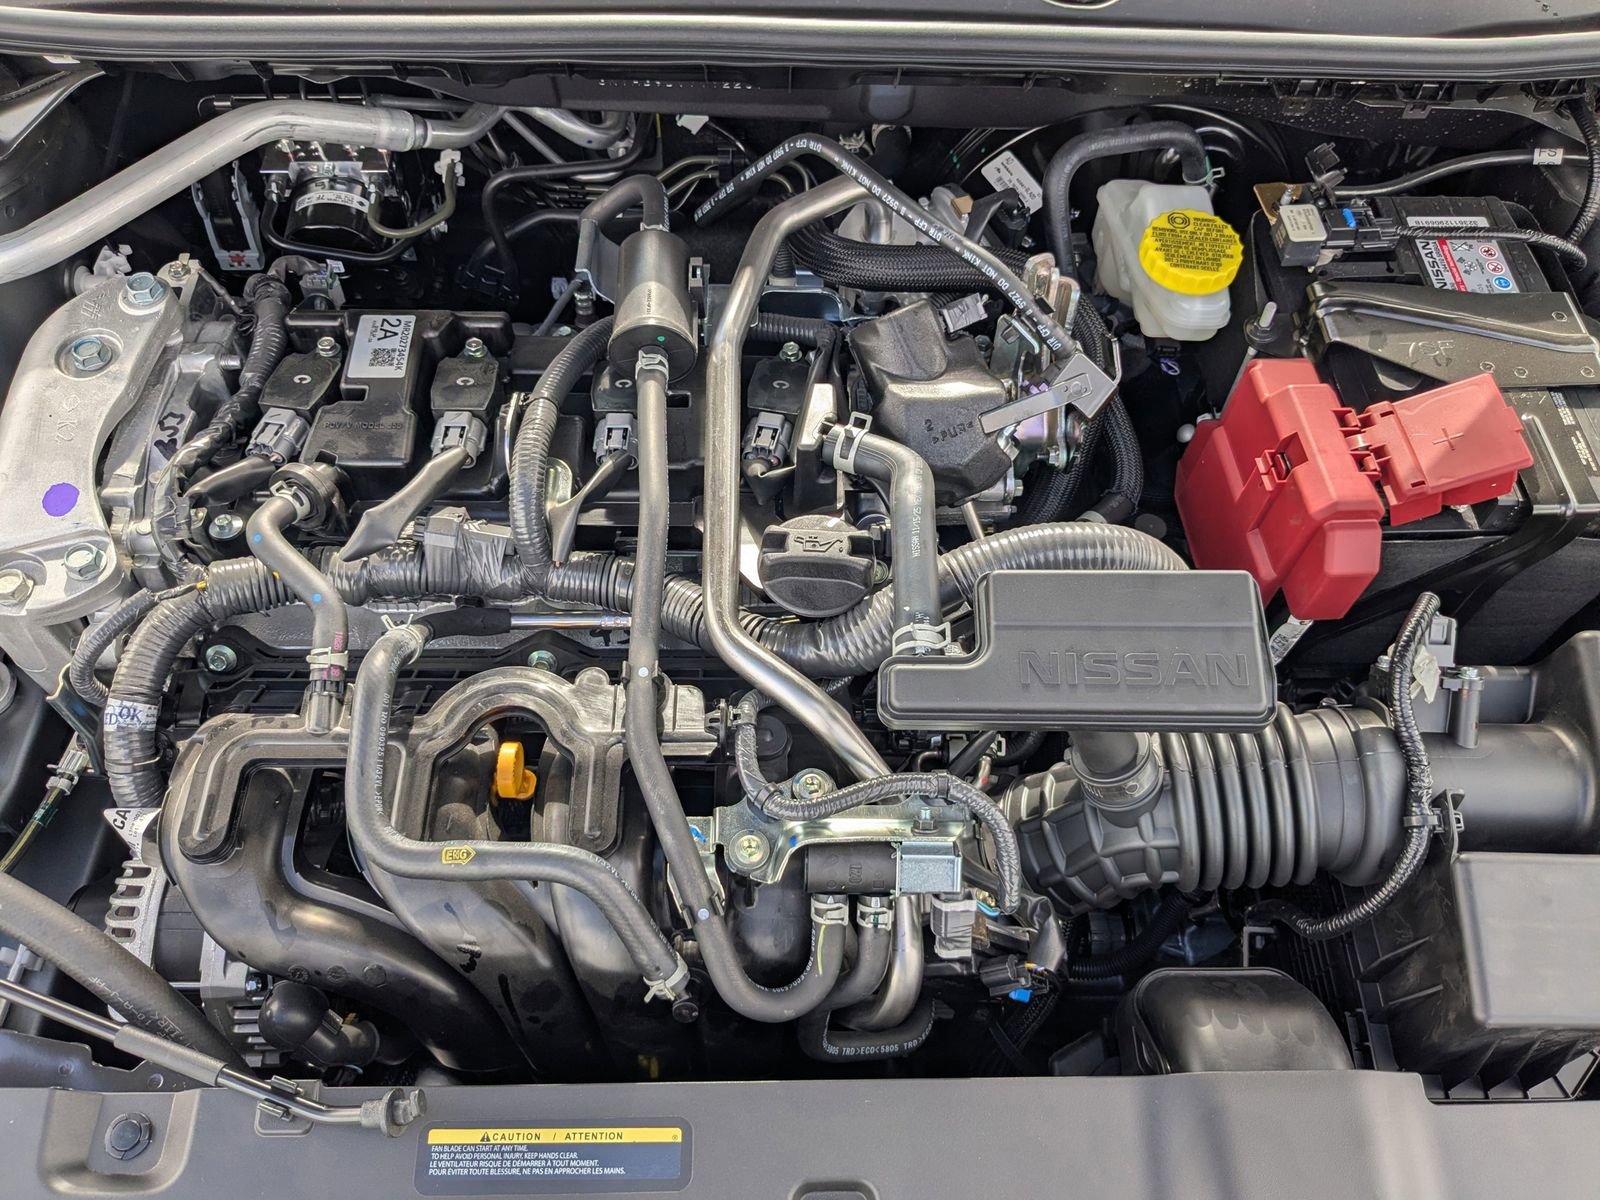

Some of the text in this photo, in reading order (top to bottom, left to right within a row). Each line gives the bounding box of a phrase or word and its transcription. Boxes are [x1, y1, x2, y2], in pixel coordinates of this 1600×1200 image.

[745, 165, 756, 179] KINK
[757, 160, 766, 172] NOT
[841, 161, 858, 176] KINK
[858, 176, 872, 190] NOT
[872, 185, 882, 196] DO
[882, 193, 899, 210] 5927
[914, 218, 928, 231] CFP
[928, 226, 942, 242] DTR
[961, 249, 982, 267] KINK
[1420, 241, 1447, 289] NISSAN
[981, 264, 998, 279] NOT
[997, 278, 1010, 291] DO
[1008, 291, 1027, 309] 5927
[377, 318, 402, 341] 2A
[1037, 324, 1050, 337] CFP
[1046, 337, 1062, 351] DTR
[912, 535, 921, 558] NISSAN
[1020, 651, 1250, 687] NISSAN
[119, 706, 142, 724] OK
[377, 727, 385, 756] 090325
[112, 810, 131, 830] CA
[446, 850, 467, 860] ENG
[492, 1132, 541, 1140] CAUTION
[565, 1132, 623, 1140] ATTENTION
